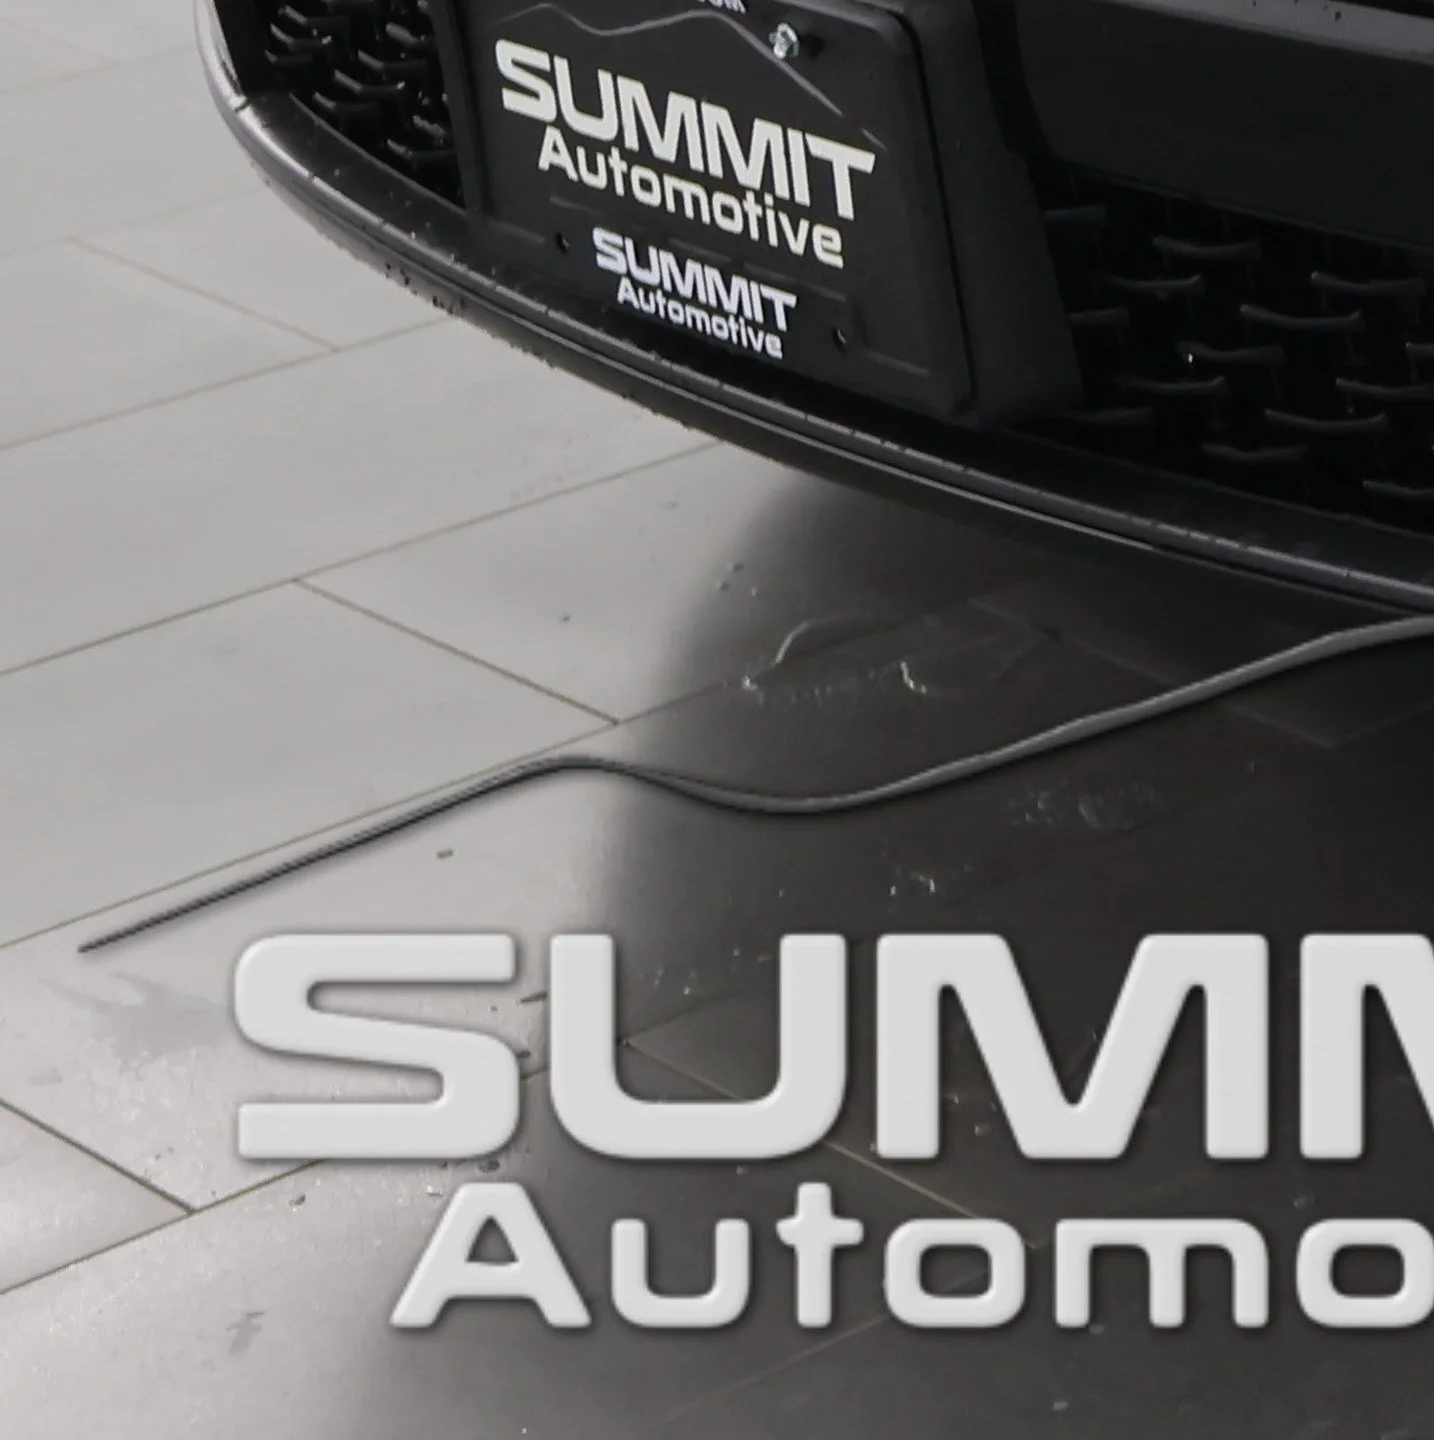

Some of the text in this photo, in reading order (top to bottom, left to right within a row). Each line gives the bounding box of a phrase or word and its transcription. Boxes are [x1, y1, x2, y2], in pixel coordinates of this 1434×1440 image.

[495, 39, 876, 220] SUMMIT
[538, 125, 845, 269] Automotive
[592, 226, 798, 332] SUMMIT
[617, 276, 784, 360] Automotive
